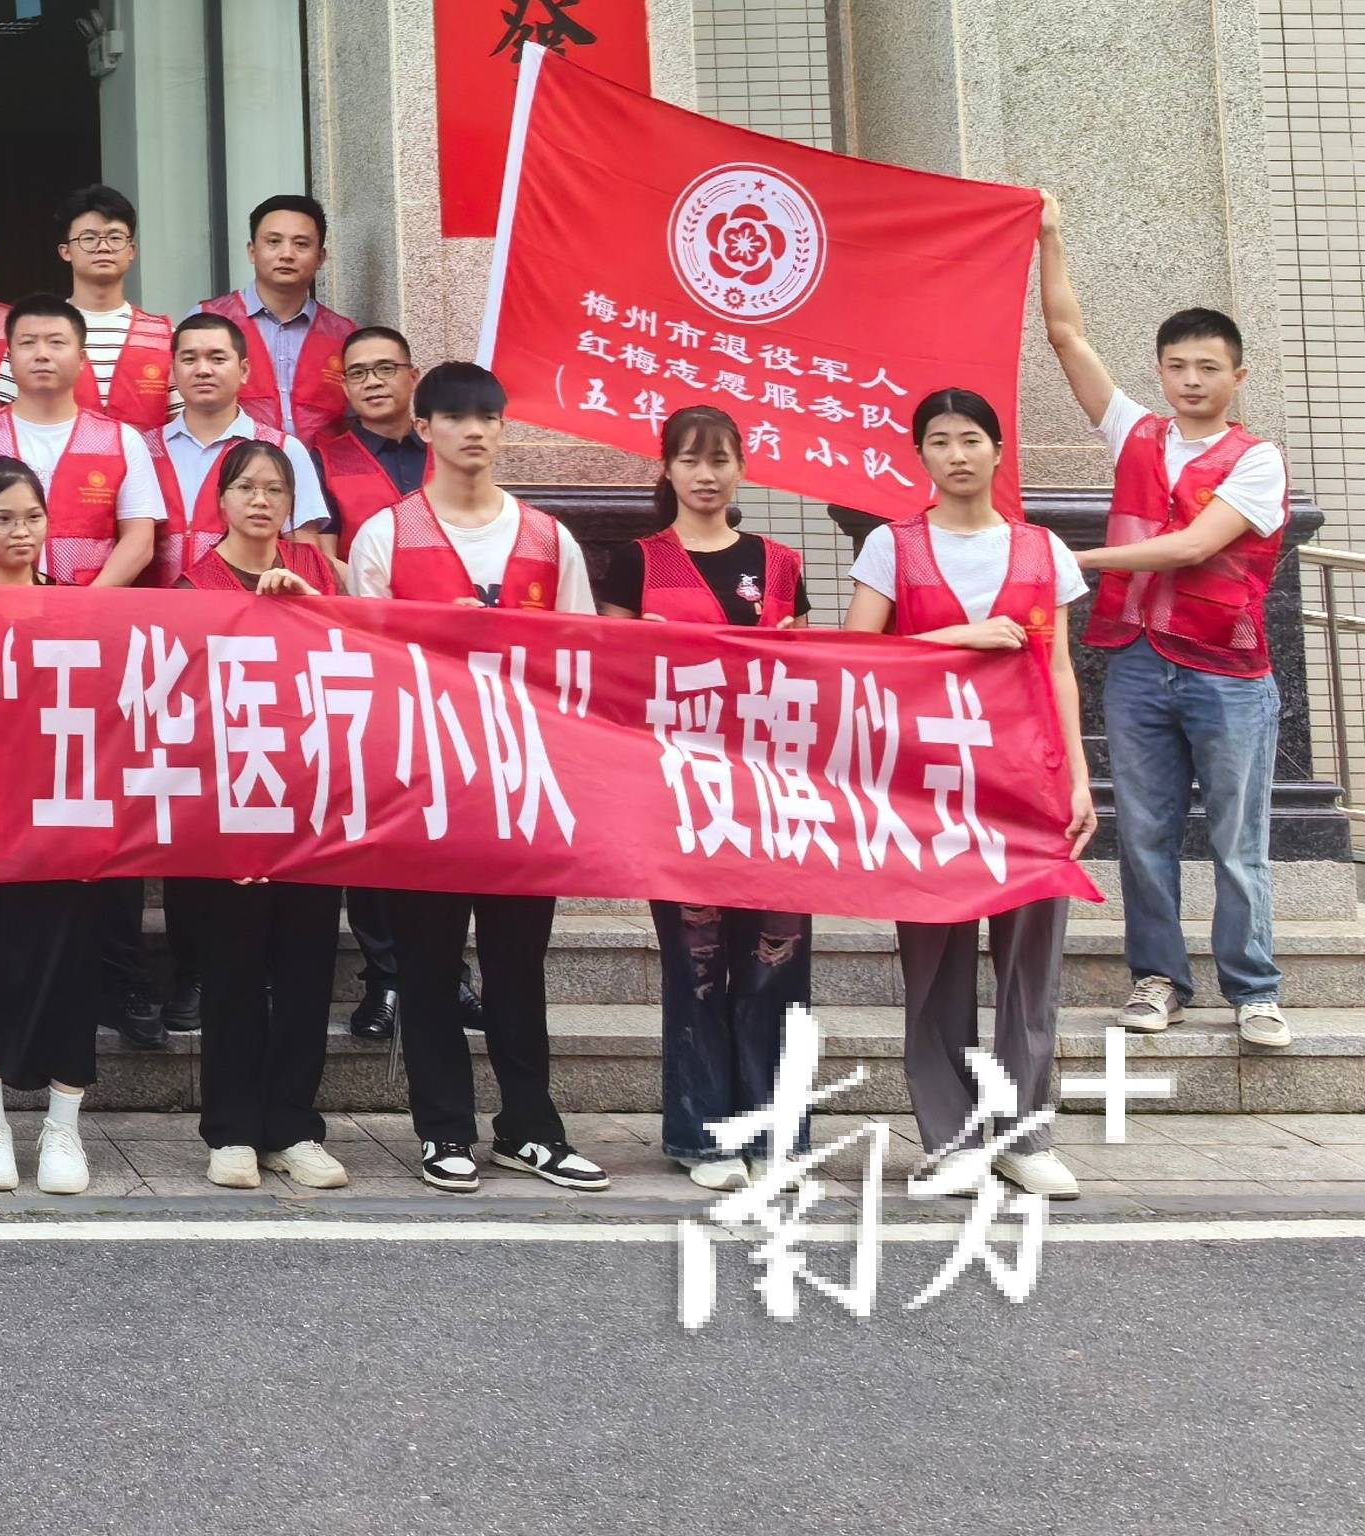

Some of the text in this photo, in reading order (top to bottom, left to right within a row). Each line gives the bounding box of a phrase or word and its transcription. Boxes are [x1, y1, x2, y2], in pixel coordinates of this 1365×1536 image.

[576, 330, 910, 434] 红梅志愿服务队
[579, 289, 908, 397] 梅州市退役军人
